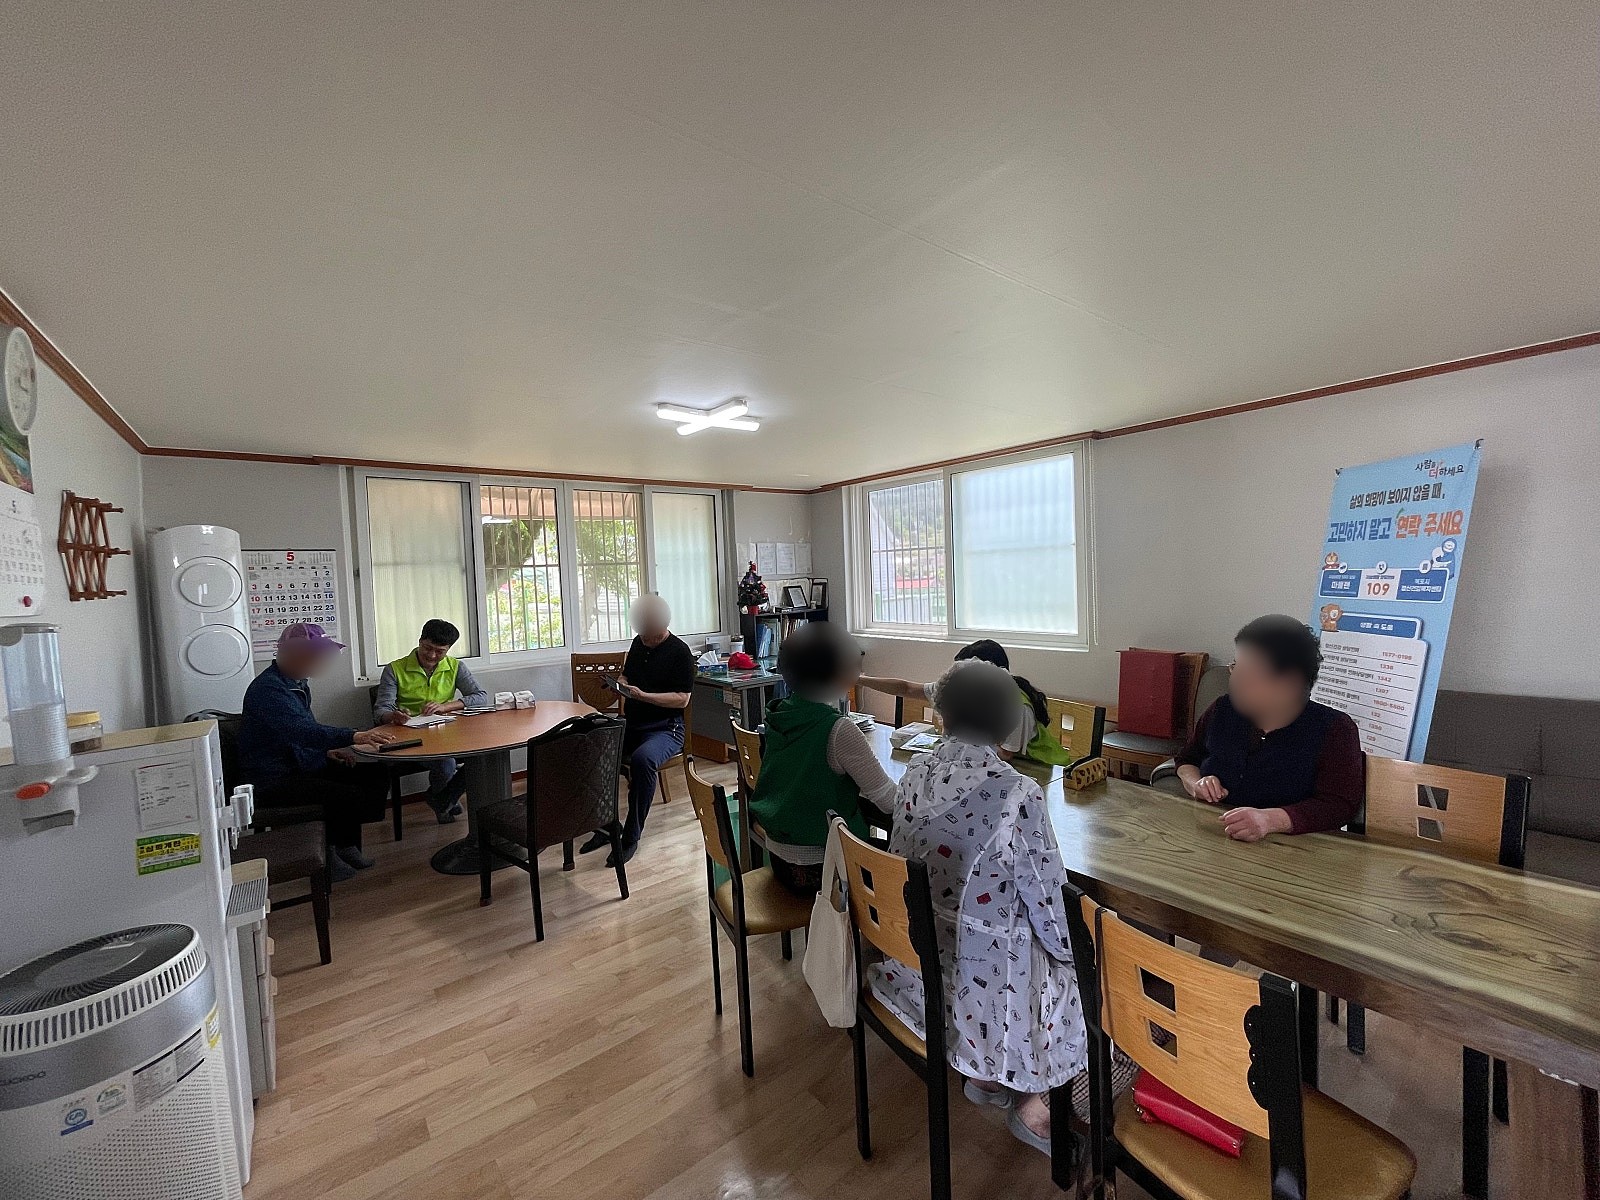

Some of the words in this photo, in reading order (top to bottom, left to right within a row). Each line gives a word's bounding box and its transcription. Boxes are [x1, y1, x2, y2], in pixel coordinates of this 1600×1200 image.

[1428, 463, 1465, 479] 더하세요
[1349, 492, 1363, 510] 삶의
[1364, 490, 1387, 507] 희망이
[1387, 486, 1412, 505] 보이지
[1412, 484, 1431, 501] 않을
[1327, 520, 1367, 543] 고민하지
[1368, 517, 1392, 541] 말고
[1395, 513, 1422, 539] 연락
[1423, 509, 1464, 537] 주세요
[286, 552, 295, 561] 5
[1366, 582, 1390, 595] 109
